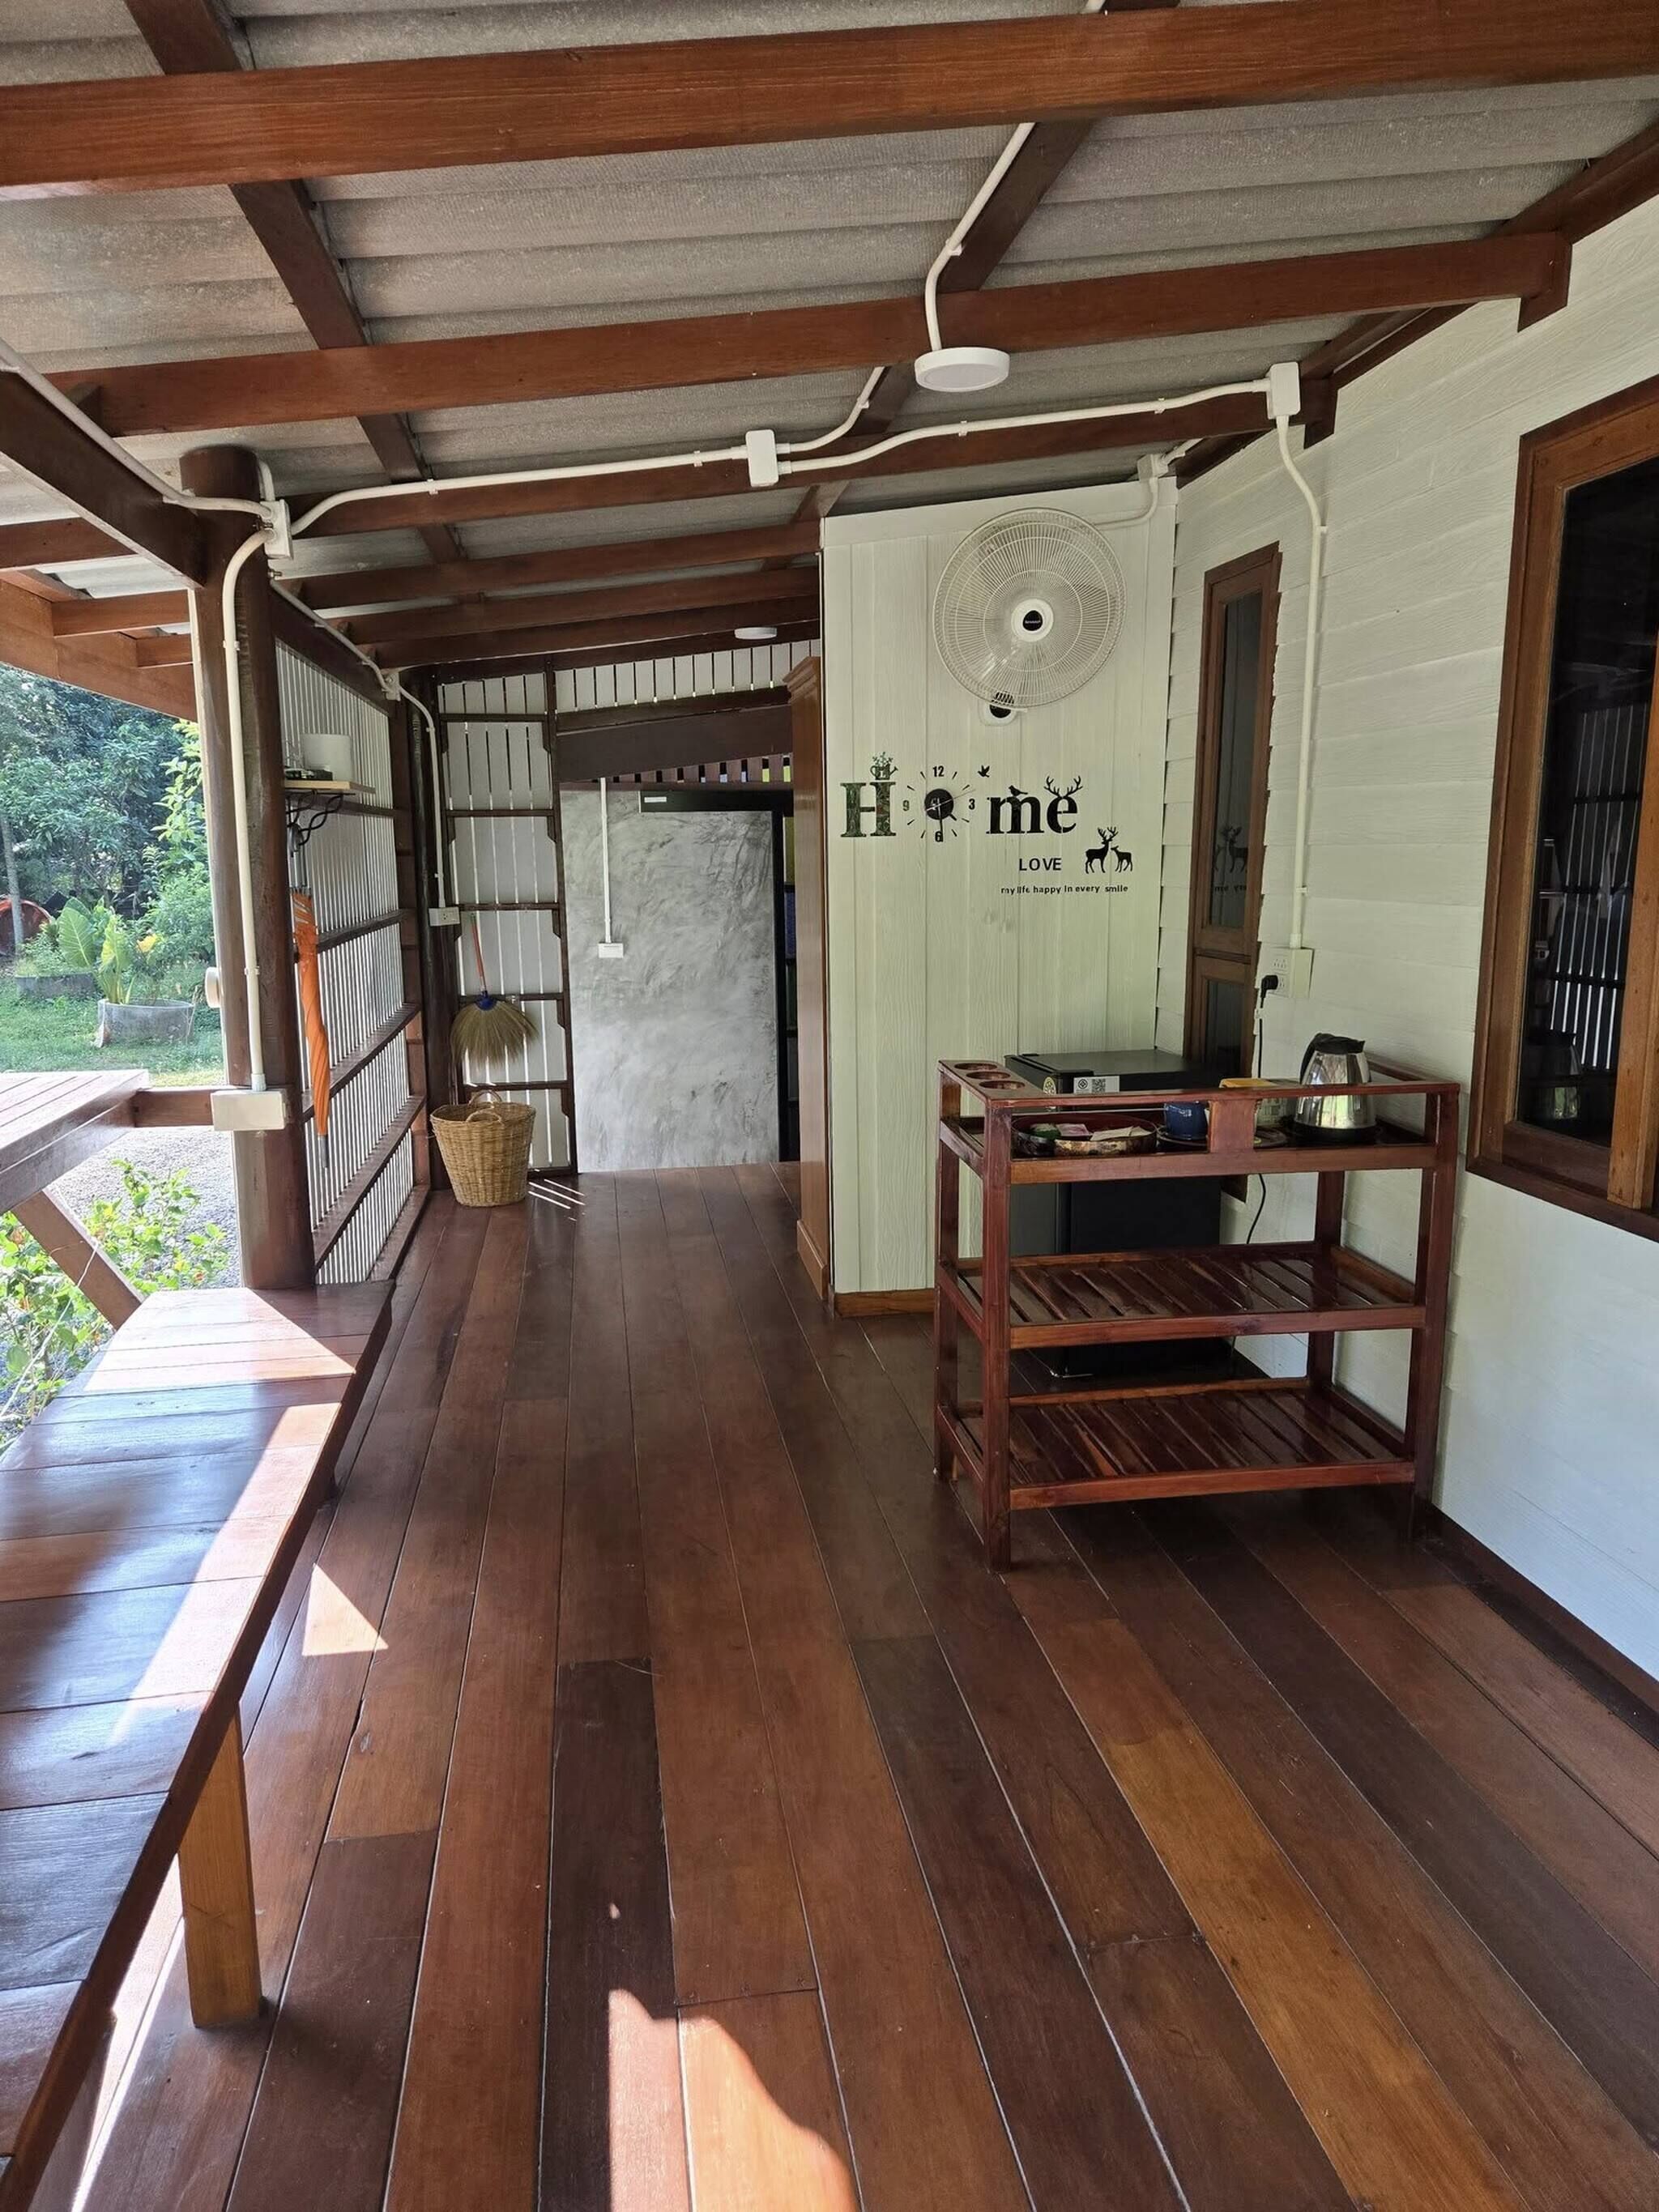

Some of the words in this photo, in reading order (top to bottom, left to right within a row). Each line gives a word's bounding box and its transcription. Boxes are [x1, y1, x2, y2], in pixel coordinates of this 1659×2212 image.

[932, 765, 945, 778] 12
[902, 799, 910, 812] 9
[968, 798, 975, 810] 3
[1019, 858, 1062, 872] LOVE
[1000, 887, 1015, 896] my
[1033, 885, 1062, 895] happy
[1075, 885, 1100, 893] every
[1105, 884, 1128, 893] smile
